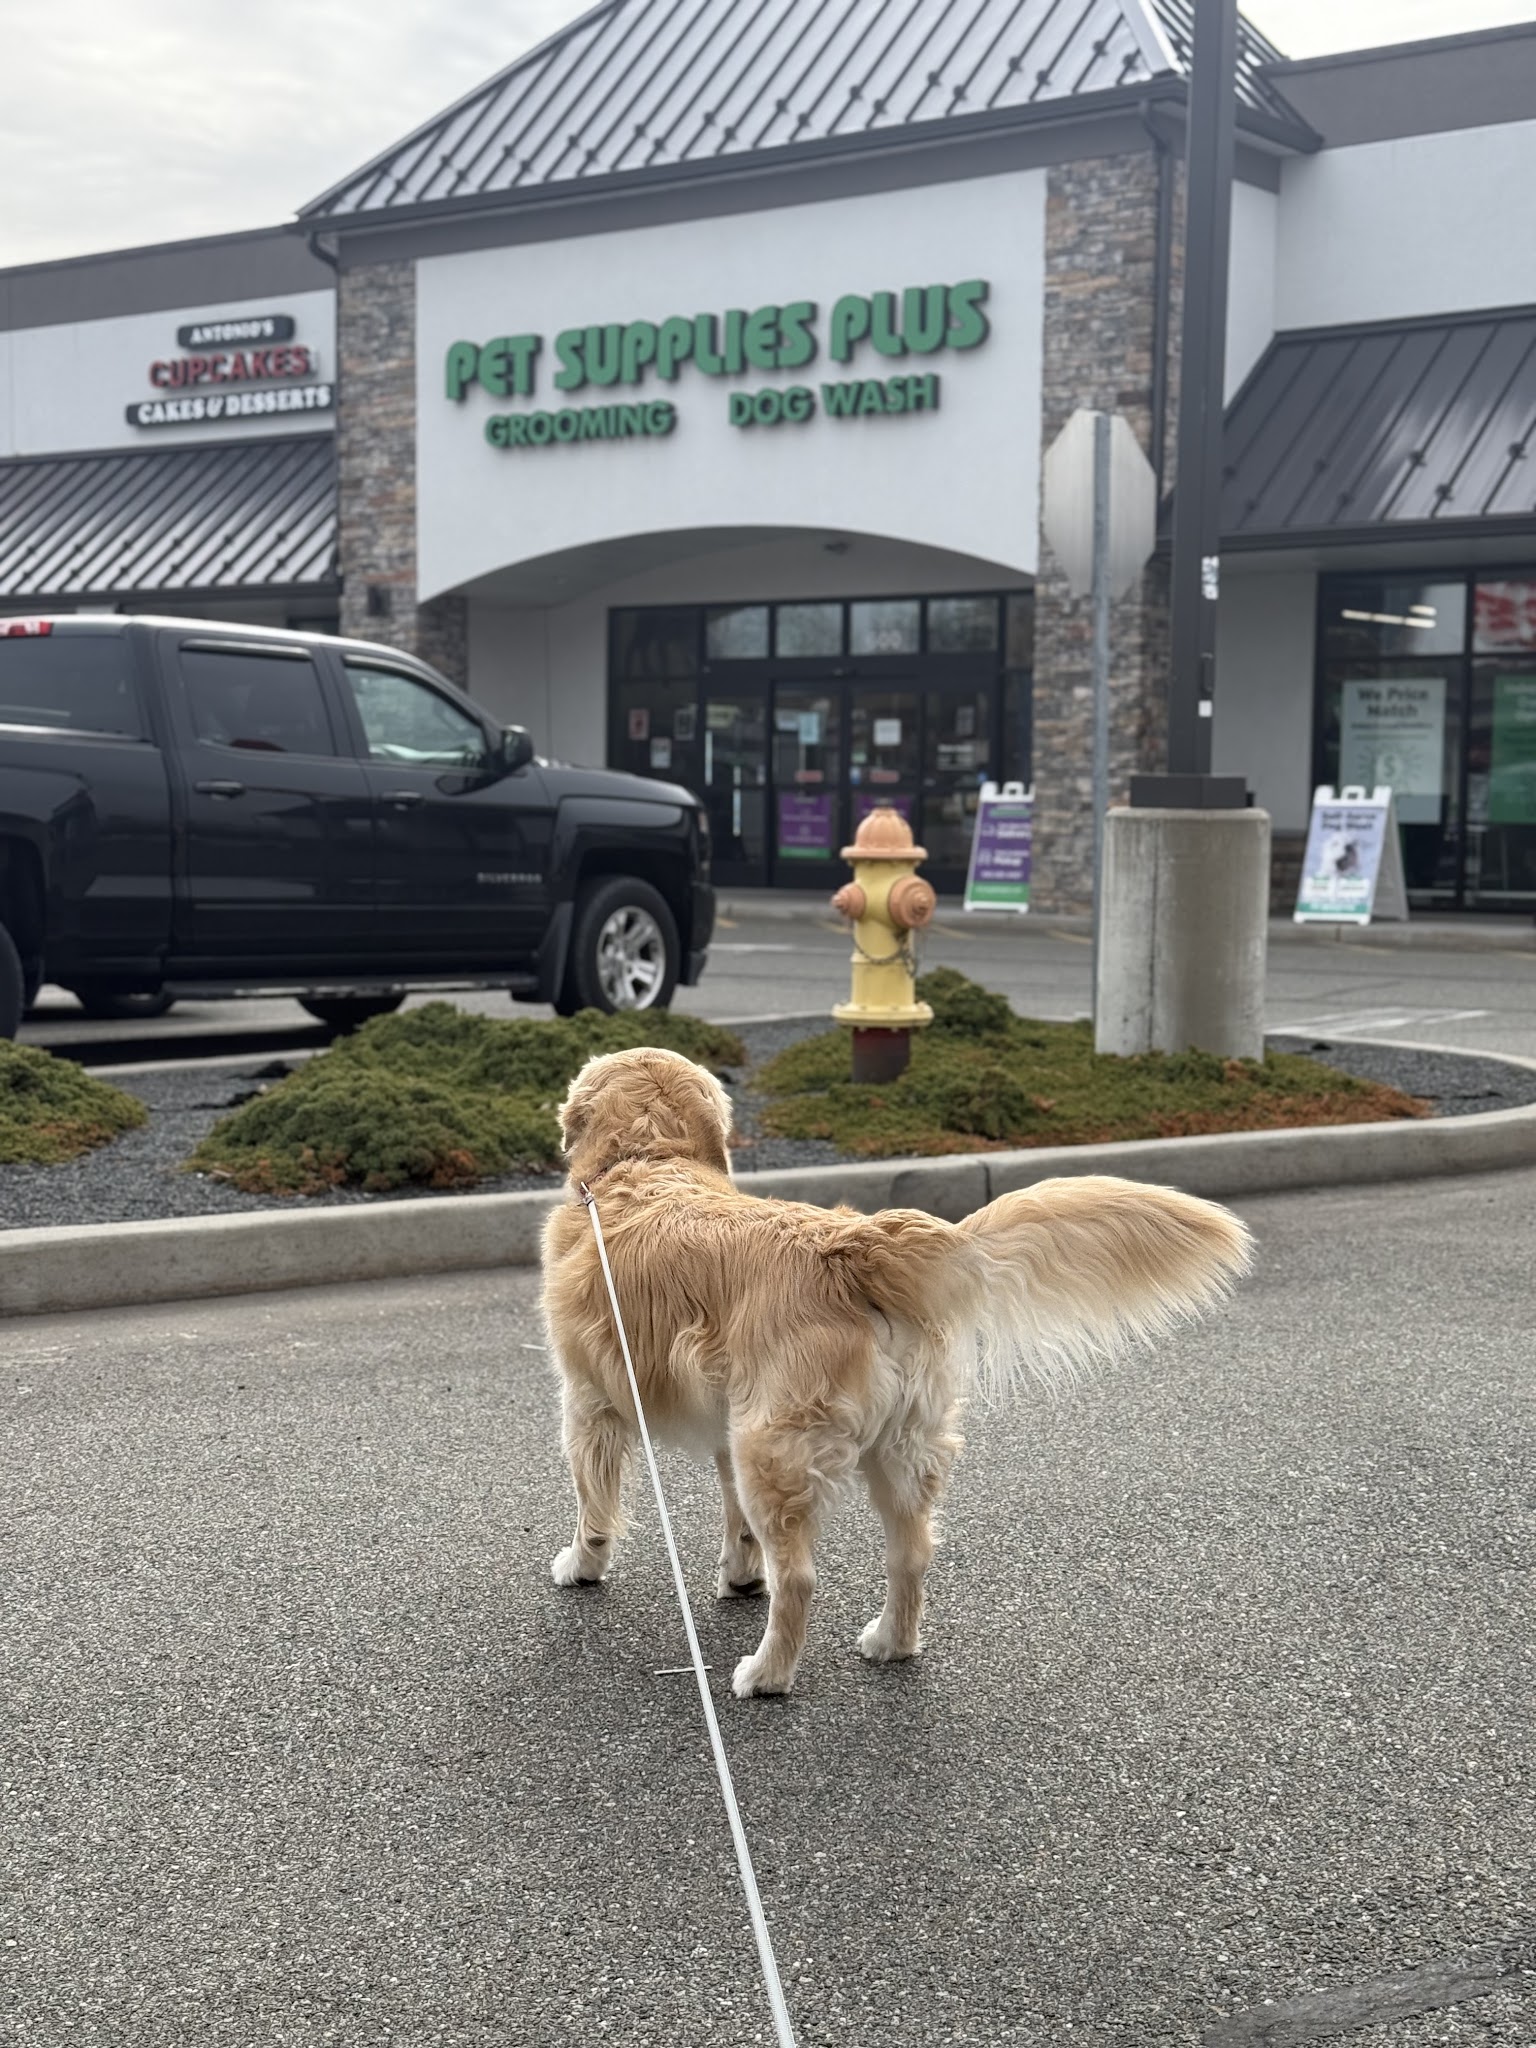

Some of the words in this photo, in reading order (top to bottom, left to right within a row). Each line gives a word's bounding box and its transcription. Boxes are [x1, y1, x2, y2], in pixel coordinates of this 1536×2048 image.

[190, 319, 275, 344] ANTONIO'S
[445, 334, 540, 401] PET
[554, 300, 816, 391] SUPPLIES
[830, 279, 988, 362] PLUS
[149, 346, 310, 389] CUPCAKES
[138, 396, 205, 424] CAKES
[225, 385, 331, 416] DESSERTS
[484, 400, 675, 448] GROOMING
[729, 386, 813, 427] DOG
[821, 373, 938, 417] WASH
[1358, 688, 1382, 701] We
[1387, 687, 1429, 701] Price
[1366, 704, 1419, 717] Match
